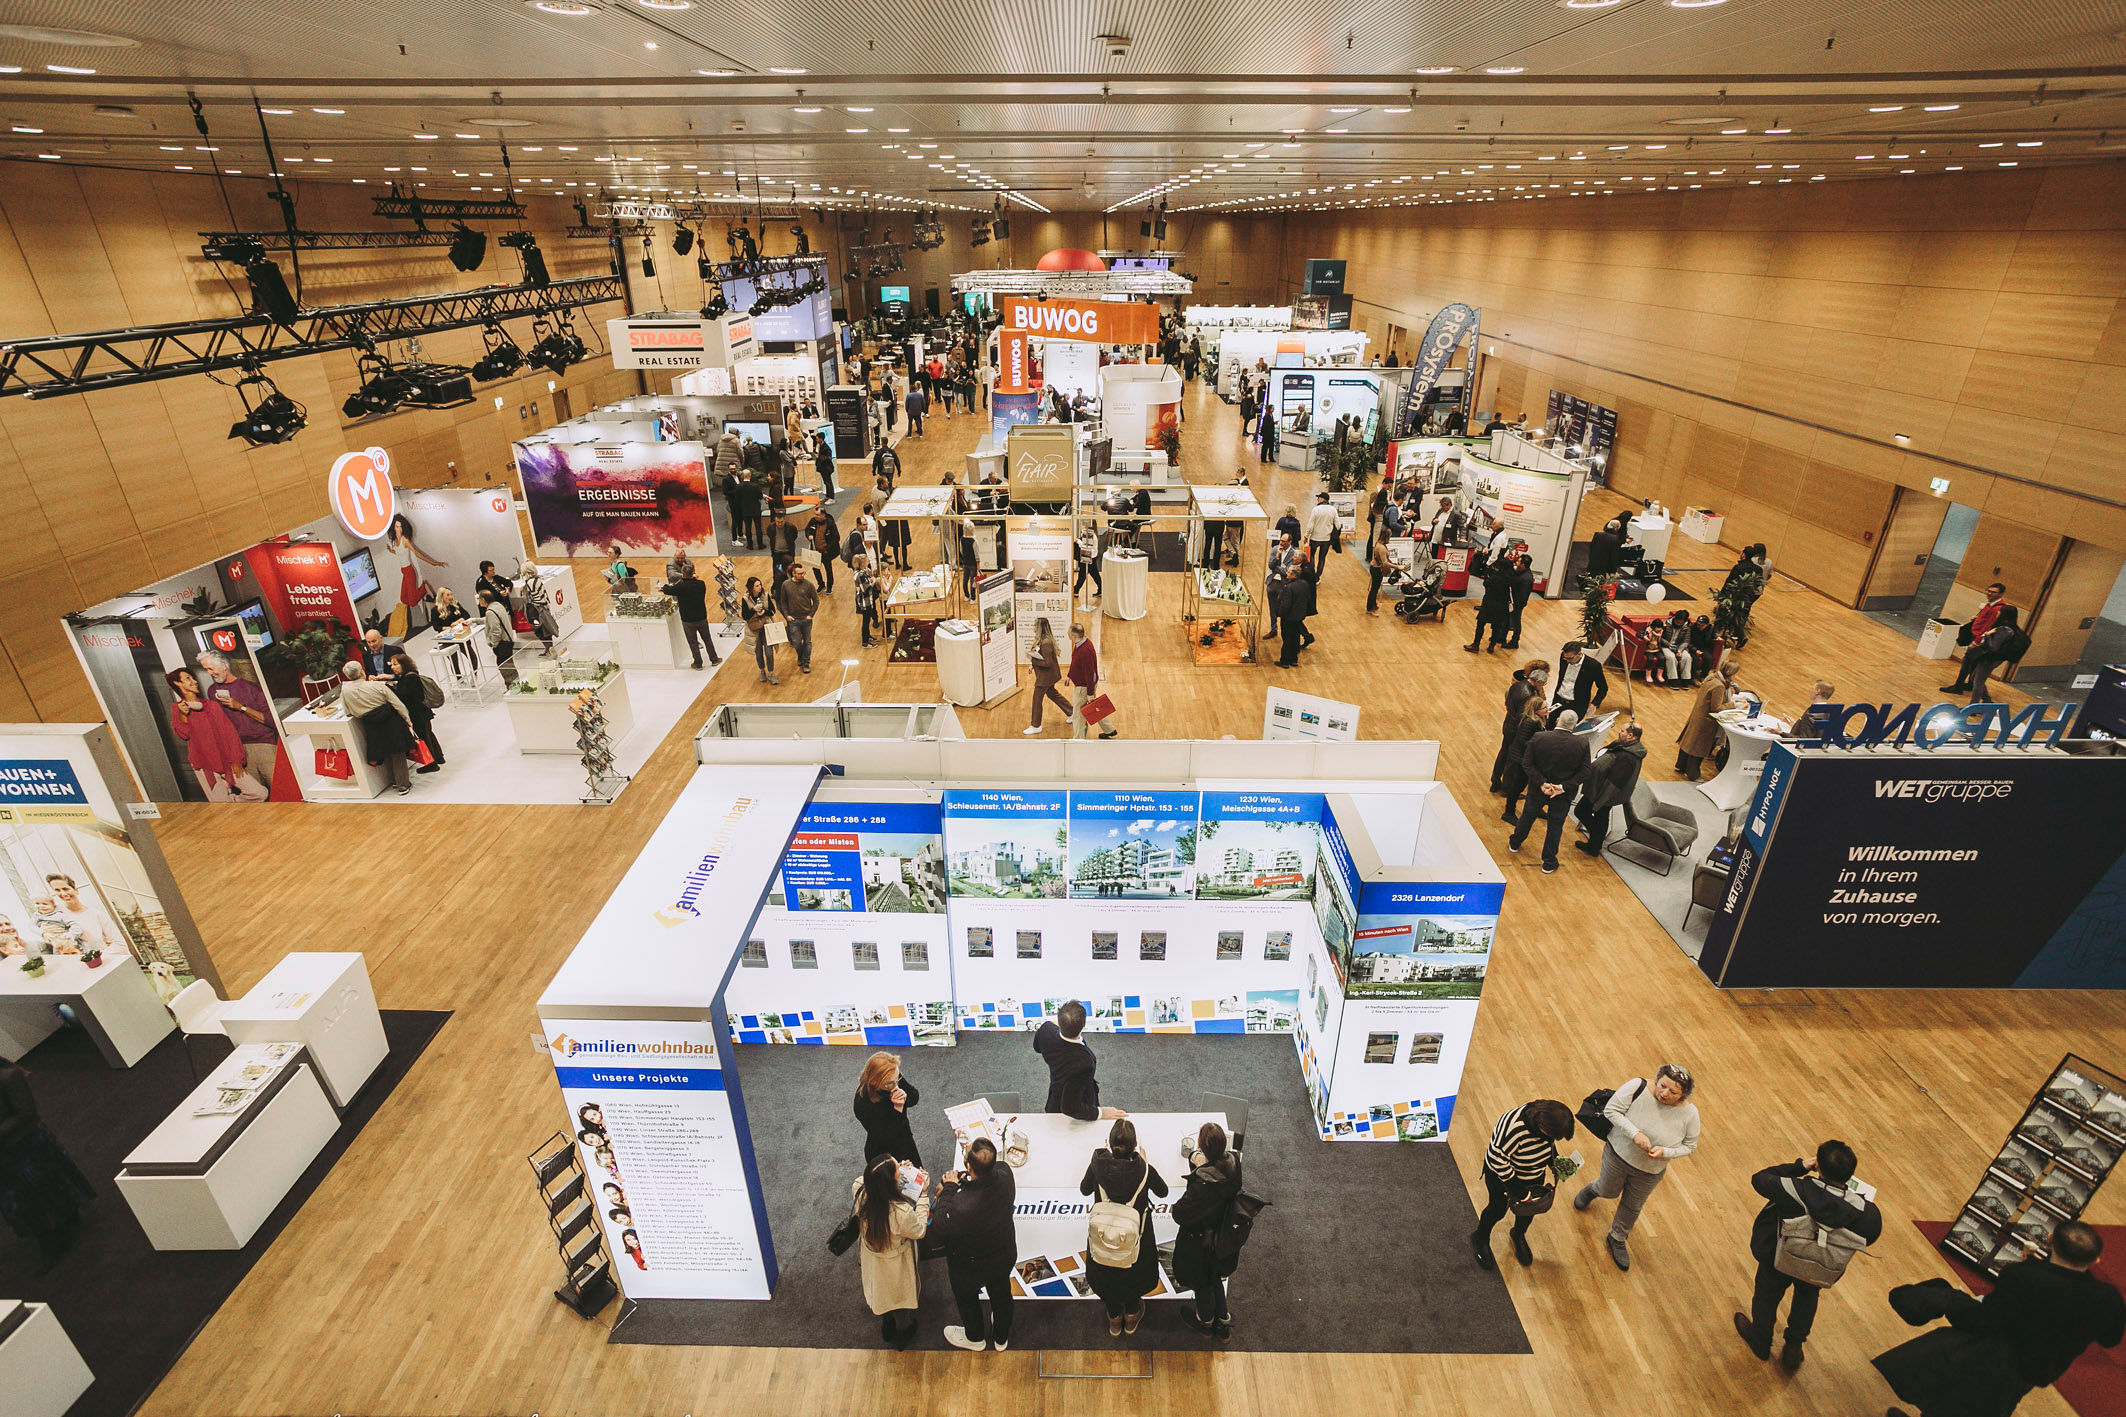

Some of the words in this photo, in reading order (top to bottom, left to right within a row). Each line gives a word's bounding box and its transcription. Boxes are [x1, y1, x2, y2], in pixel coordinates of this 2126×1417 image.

[1015, 305, 1098, 335] BUWOG
[629, 331, 703, 346] STRABAG
[729, 322, 751, 342] STRABAG
[639, 357, 663, 366] REAL
[668, 357, 701, 365] ESTATE
[1011, 338, 1022, 387] BUWOG
[1408, 309, 1465, 411] PROsystem
[1017, 463, 1059, 483] FLAIR
[578, 489, 657, 501] ERGEBNISSE
[406, 501, 447, 511] Mischek
[276, 555, 315, 565] Mischek
[285, 583, 339, 595] Lebens-
[152, 586, 195, 611] Mischek
[290, 595, 332, 605] freude
[82, 634, 145, 648] Mischek
[1769, 768, 1782, 790] NOE
[1002, 794, 1023, 803] Wien,
[1875, 780, 2012, 803] WETgruppe
[1132, 795, 1155, 803] Wien,
[1239, 796, 1257, 804] 1230
[1260, 796, 1283, 804] Wien,
[1758, 791, 1773, 819] HYPO
[947, 802, 1001, 810] Schleusenstr.
[1002, 803, 1048, 811] 1A/Bahnstr.
[1077, 803, 1129, 813] Simmeringer
[1130, 804, 1157, 813] Hptstr.
[1222, 804, 1275, 814] Meischlgasse
[1277, 805, 1301, 814] 4A+B
[870, 816, 887, 824] 288
[829, 838, 855, 846] Mieten
[1848, 845, 1979, 861] Willkommen
[1724, 848, 1753, 914] WETgruppe
[1838, 868, 1856, 883] in
[1861, 868, 1918, 883] Ihrem
[1391, 894, 1413, 902] 2326
[1415, 894, 1465, 902] Lanzendorf
[1828, 889, 1918, 904] Zuhause
[1823, 913, 1858, 924] von
[1861, 913, 1942, 927] morgen.
[562, 1036, 714, 1056] familienwohnbau
[592, 1073, 635, 1083] Unsere
[638, 1074, 689, 1084] Projekte
